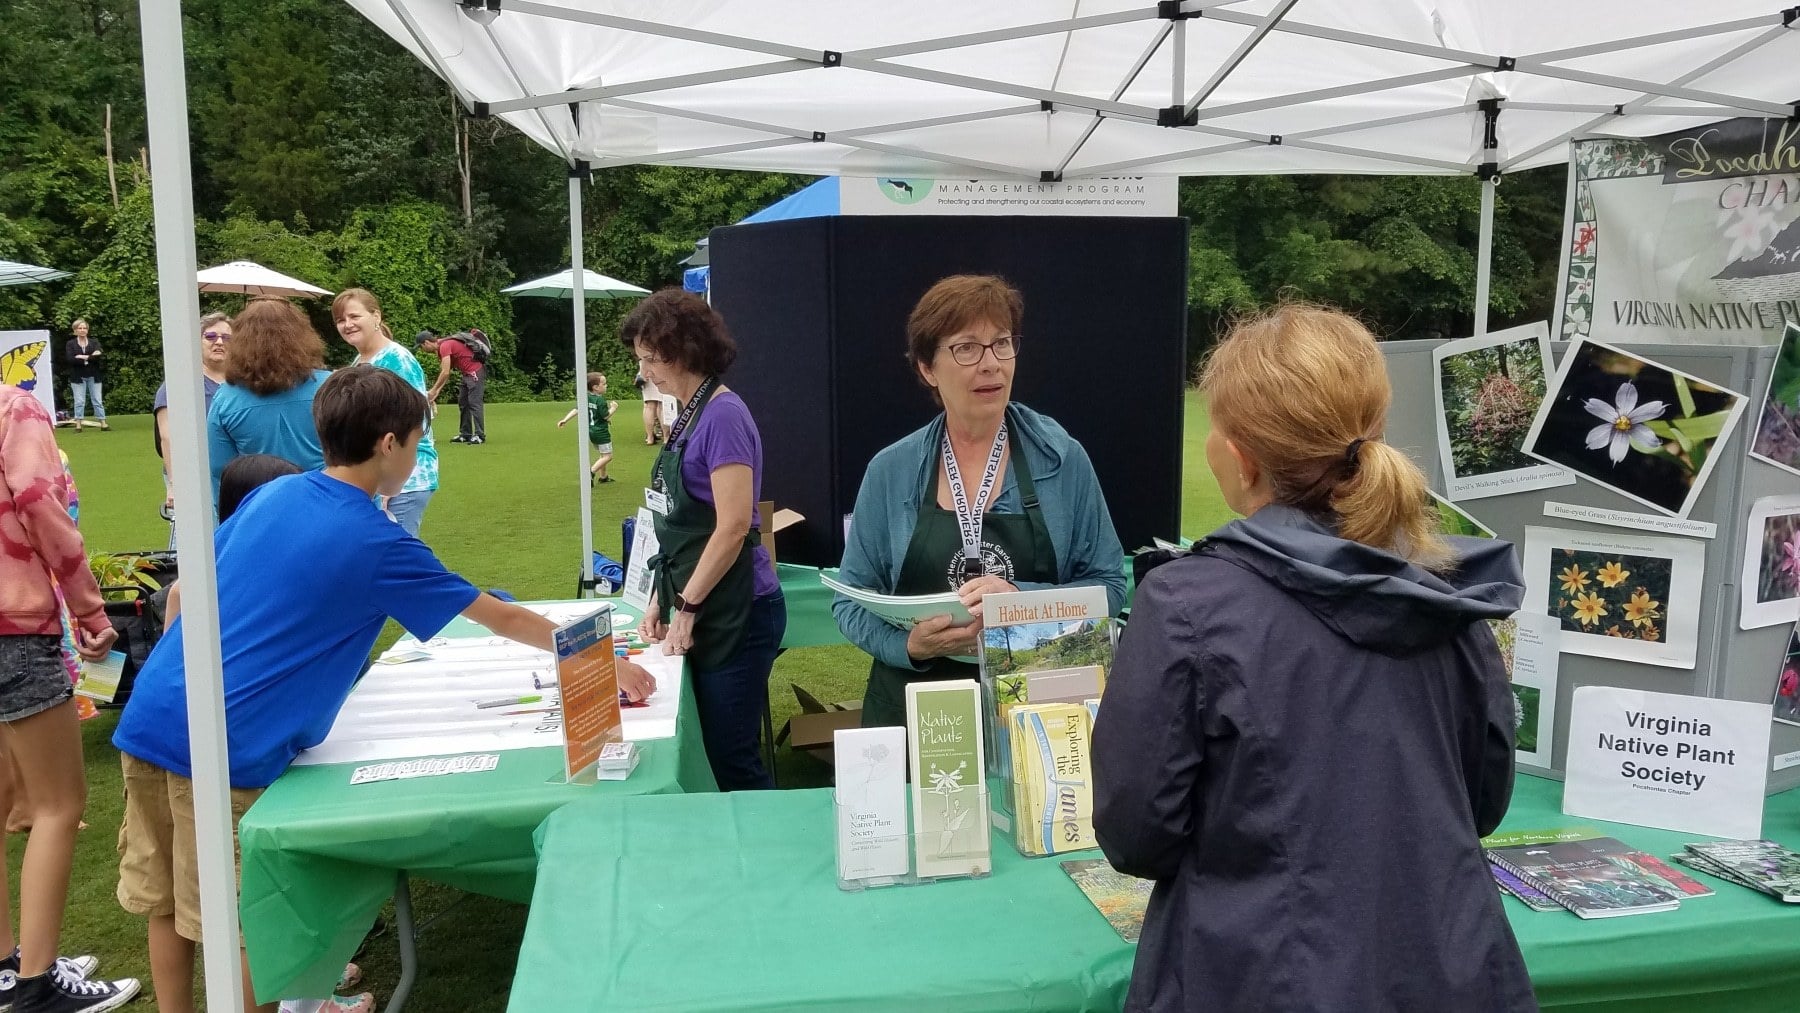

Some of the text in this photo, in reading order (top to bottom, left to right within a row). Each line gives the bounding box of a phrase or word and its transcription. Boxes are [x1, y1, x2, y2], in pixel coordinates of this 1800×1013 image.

[939, 184, 1145, 193] MANAGEMENT PROGRAM
[937, 198, 970, 206] Protecting
[986, 198, 1028, 206] strengthening
[1613, 300, 1687, 330] VIRGINIA
[1689, 302, 1775, 331] NATIVE
[671, 409, 693, 442] MASTER
[1454, 483, 1474, 492] Devil's
[1476, 480, 1499, 488] Walking
[1500, 477, 1516, 485] Stick
[1554, 506, 1587, 518] Blue-eyed
[1588, 511, 1606, 520] Grass
[947, 547, 965, 575] Henric
[998, 601, 1088, 623] Habitat At Home
[920, 709, 963, 727] Native
[1625, 710, 1711, 737] Virginia
[921, 725, 963, 745] Plants
[1065, 714, 1083, 775] Exploring
[1598, 732, 1736, 766] Native Plant
[1056, 755, 1070, 775] the
[1620, 761, 1706, 791] Society
[1632, 783, 1691, 796] Pocahontas Chapter
[850, 813, 877, 822] Virginia
[1049, 774, 1086, 843] James
[874, 819, 891, 827] Plant
[850, 830, 875, 838] Society
